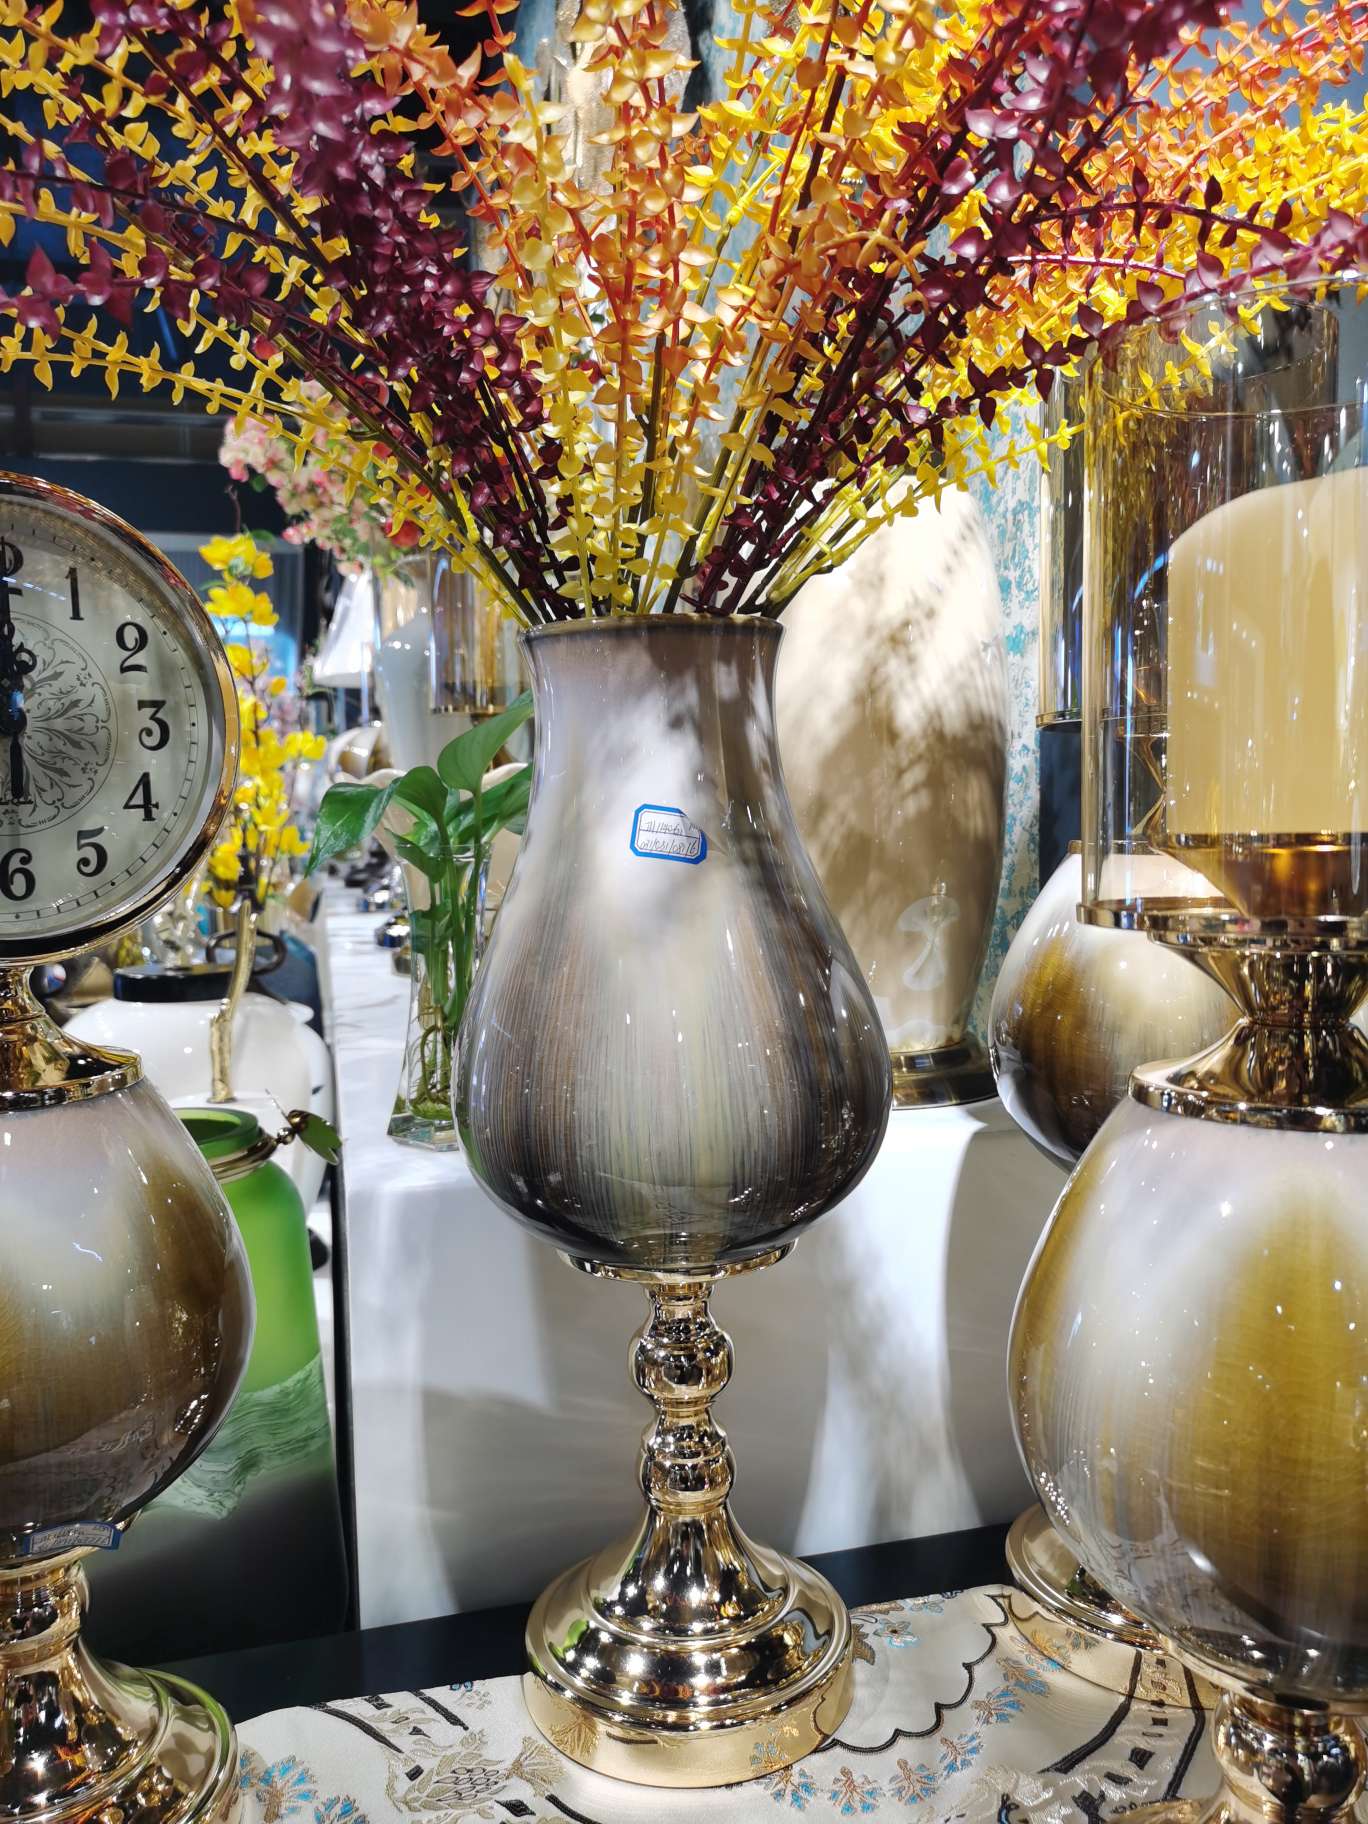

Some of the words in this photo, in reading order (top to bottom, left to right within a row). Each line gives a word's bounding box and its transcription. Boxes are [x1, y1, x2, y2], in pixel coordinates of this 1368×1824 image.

[65, 567, 84, 621] 1
[115, 622, 148, 674] 2
[137, 699, 170, 751] 3
[122, 772, 160, 821] 4
[0, 848, 36, 901] 6
[76, 826, 108, 877] 5
